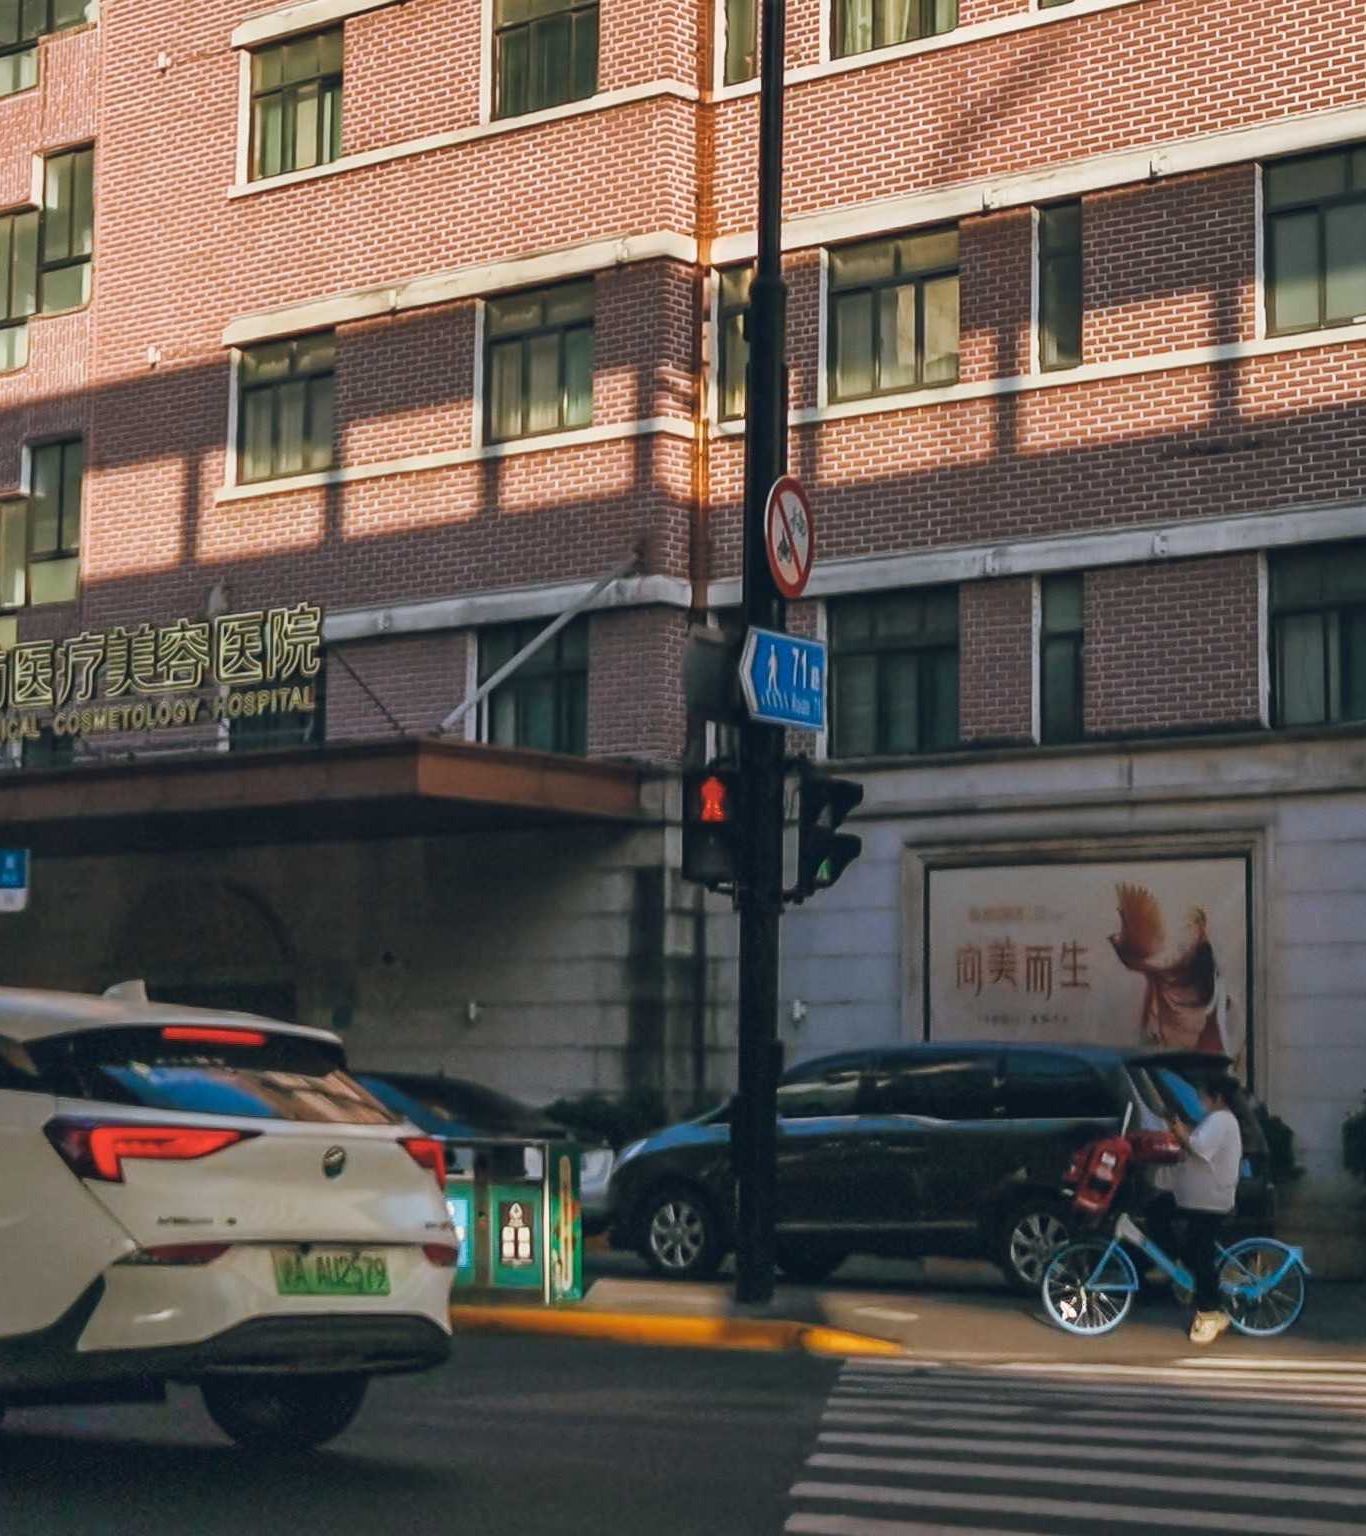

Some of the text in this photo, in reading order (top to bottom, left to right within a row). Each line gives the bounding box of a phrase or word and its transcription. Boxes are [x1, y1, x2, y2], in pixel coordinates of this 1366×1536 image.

[792, 646, 807, 689] 71
[53, 697, 202, 736] COSMETOLOGY
[214, 685, 316, 721] HOSPITAL
[955, 936, 1091, 1001] 向美而生
